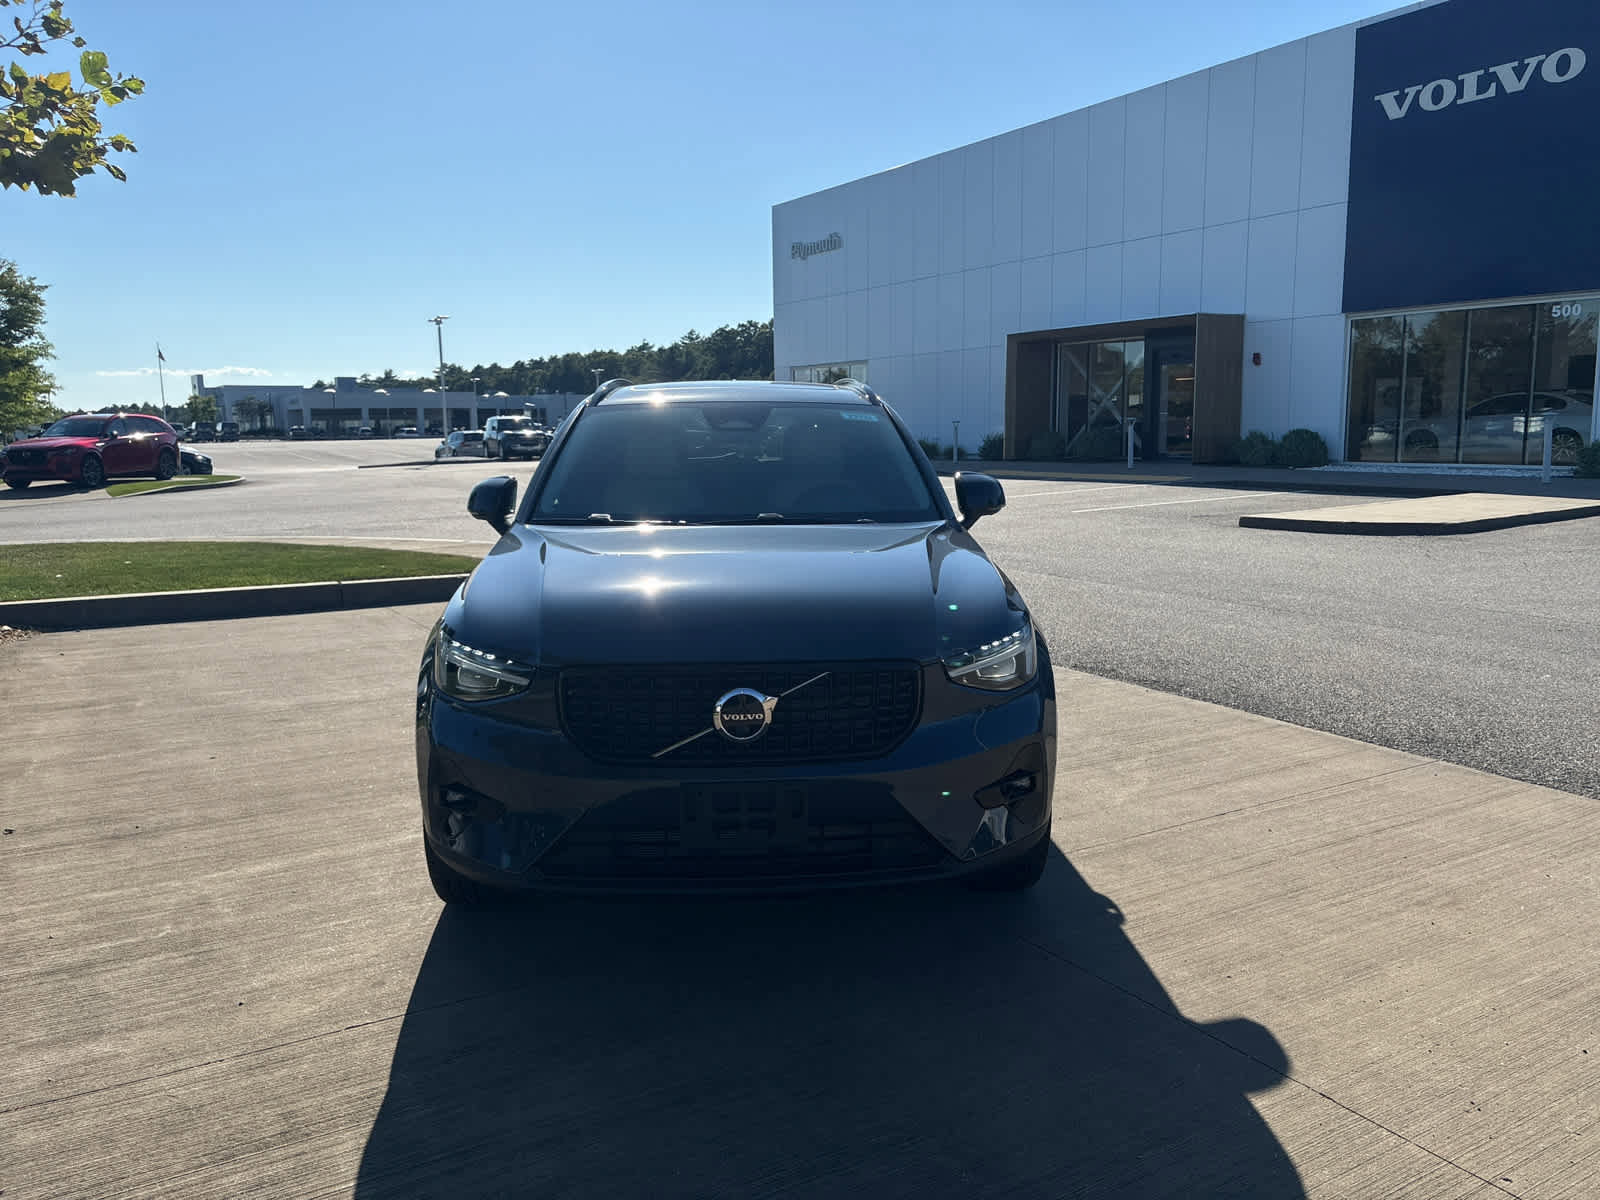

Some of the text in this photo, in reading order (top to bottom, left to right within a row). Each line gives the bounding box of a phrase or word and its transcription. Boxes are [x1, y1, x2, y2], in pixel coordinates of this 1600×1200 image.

[1374, 47, 1587, 120] VOLVO
[1551, 303, 1582, 318] 500
[722, 713, 764, 721] VOLVO
